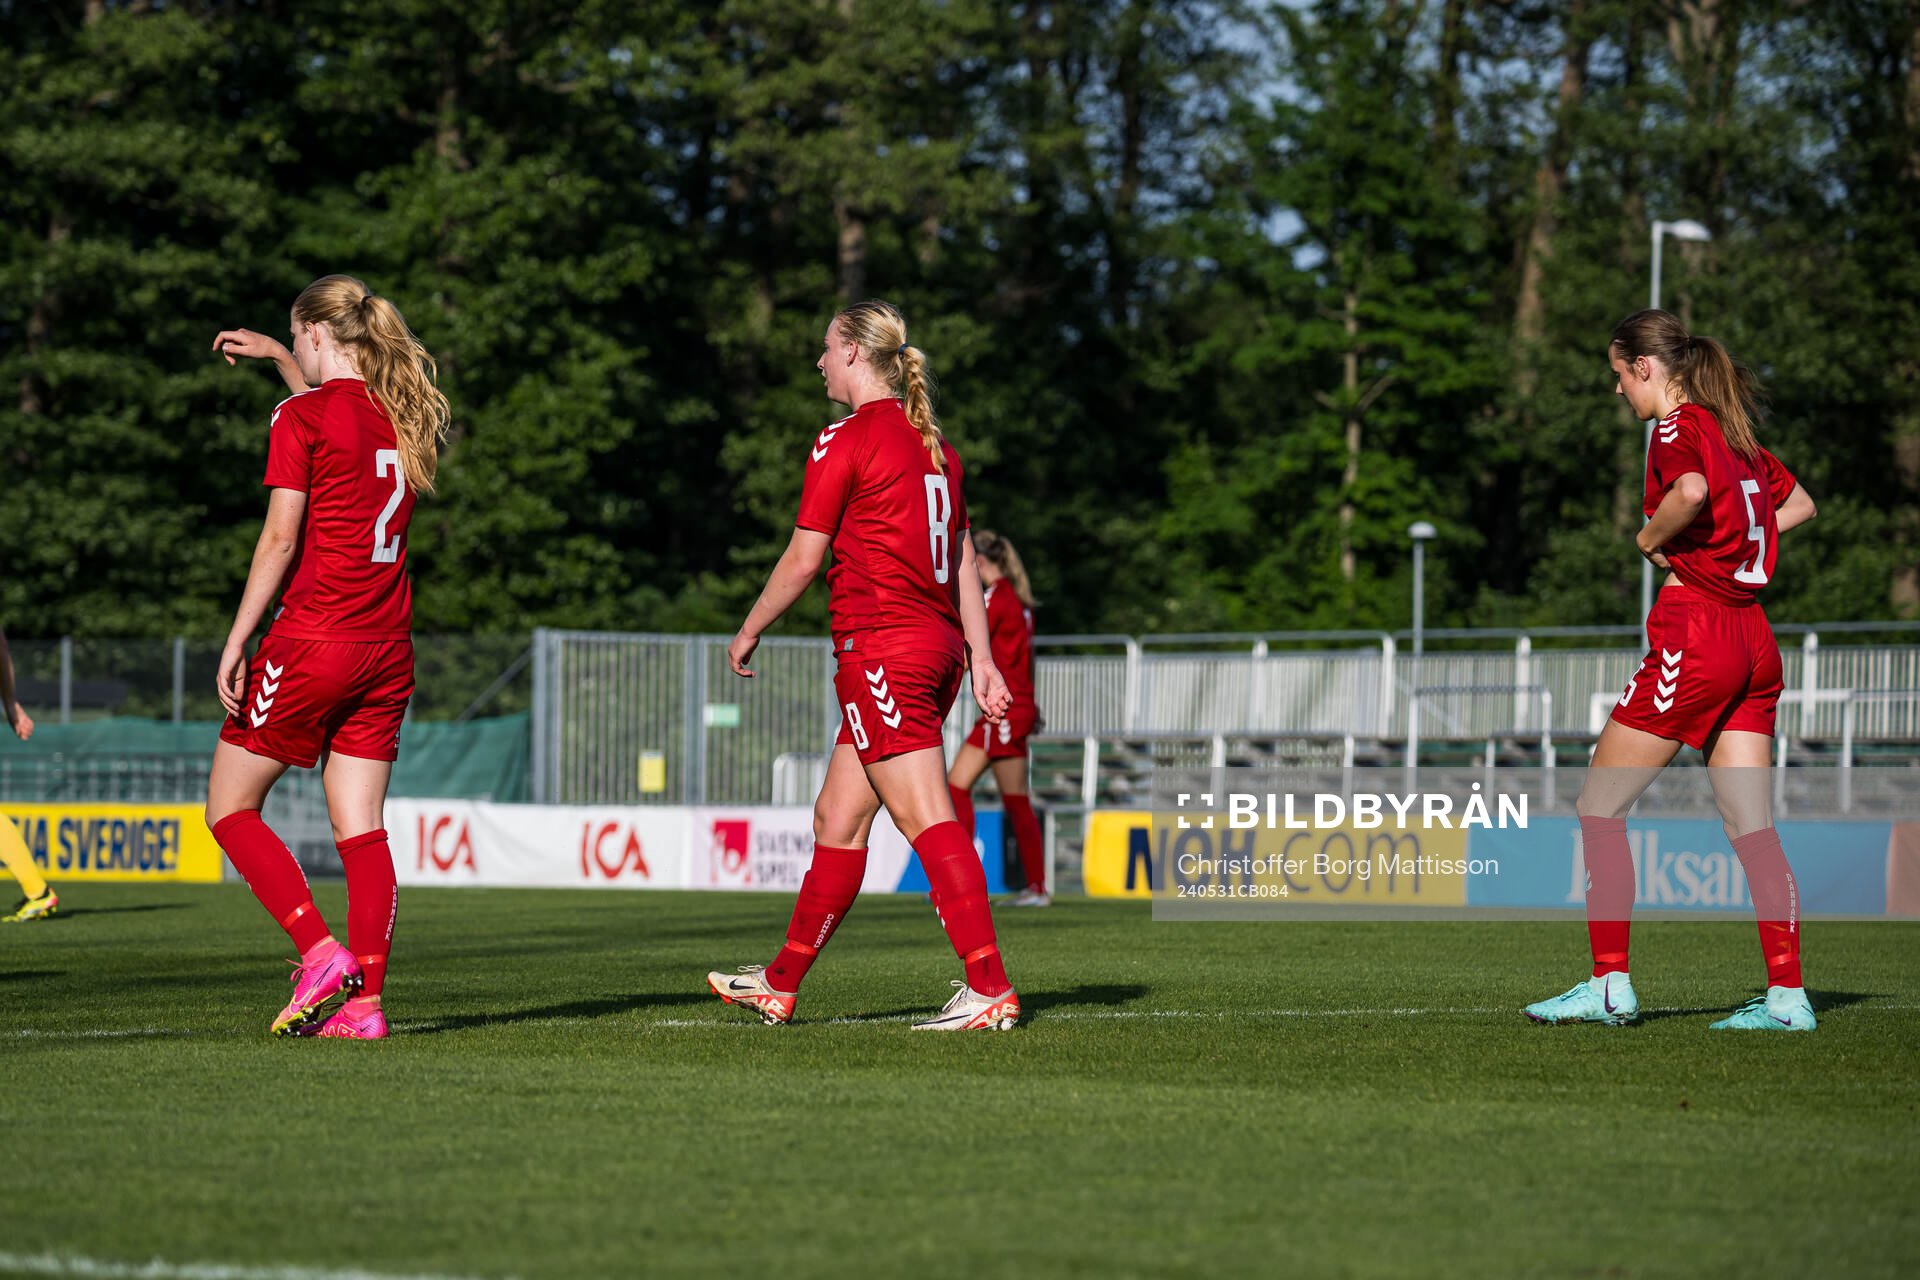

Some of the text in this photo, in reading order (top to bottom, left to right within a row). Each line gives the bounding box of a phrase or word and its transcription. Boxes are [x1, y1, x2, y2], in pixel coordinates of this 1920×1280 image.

[371, 449, 406, 562] 2
[924, 474, 951, 584] 8
[1734, 480, 1769, 584] 5
[845, 702, 869, 750] 8
[57, 817, 180, 871] SVERIGE!
[417, 814, 477, 873] ICA
[582, 821, 652, 879] ICA
[1785, 873, 1796, 934] DANMARK
